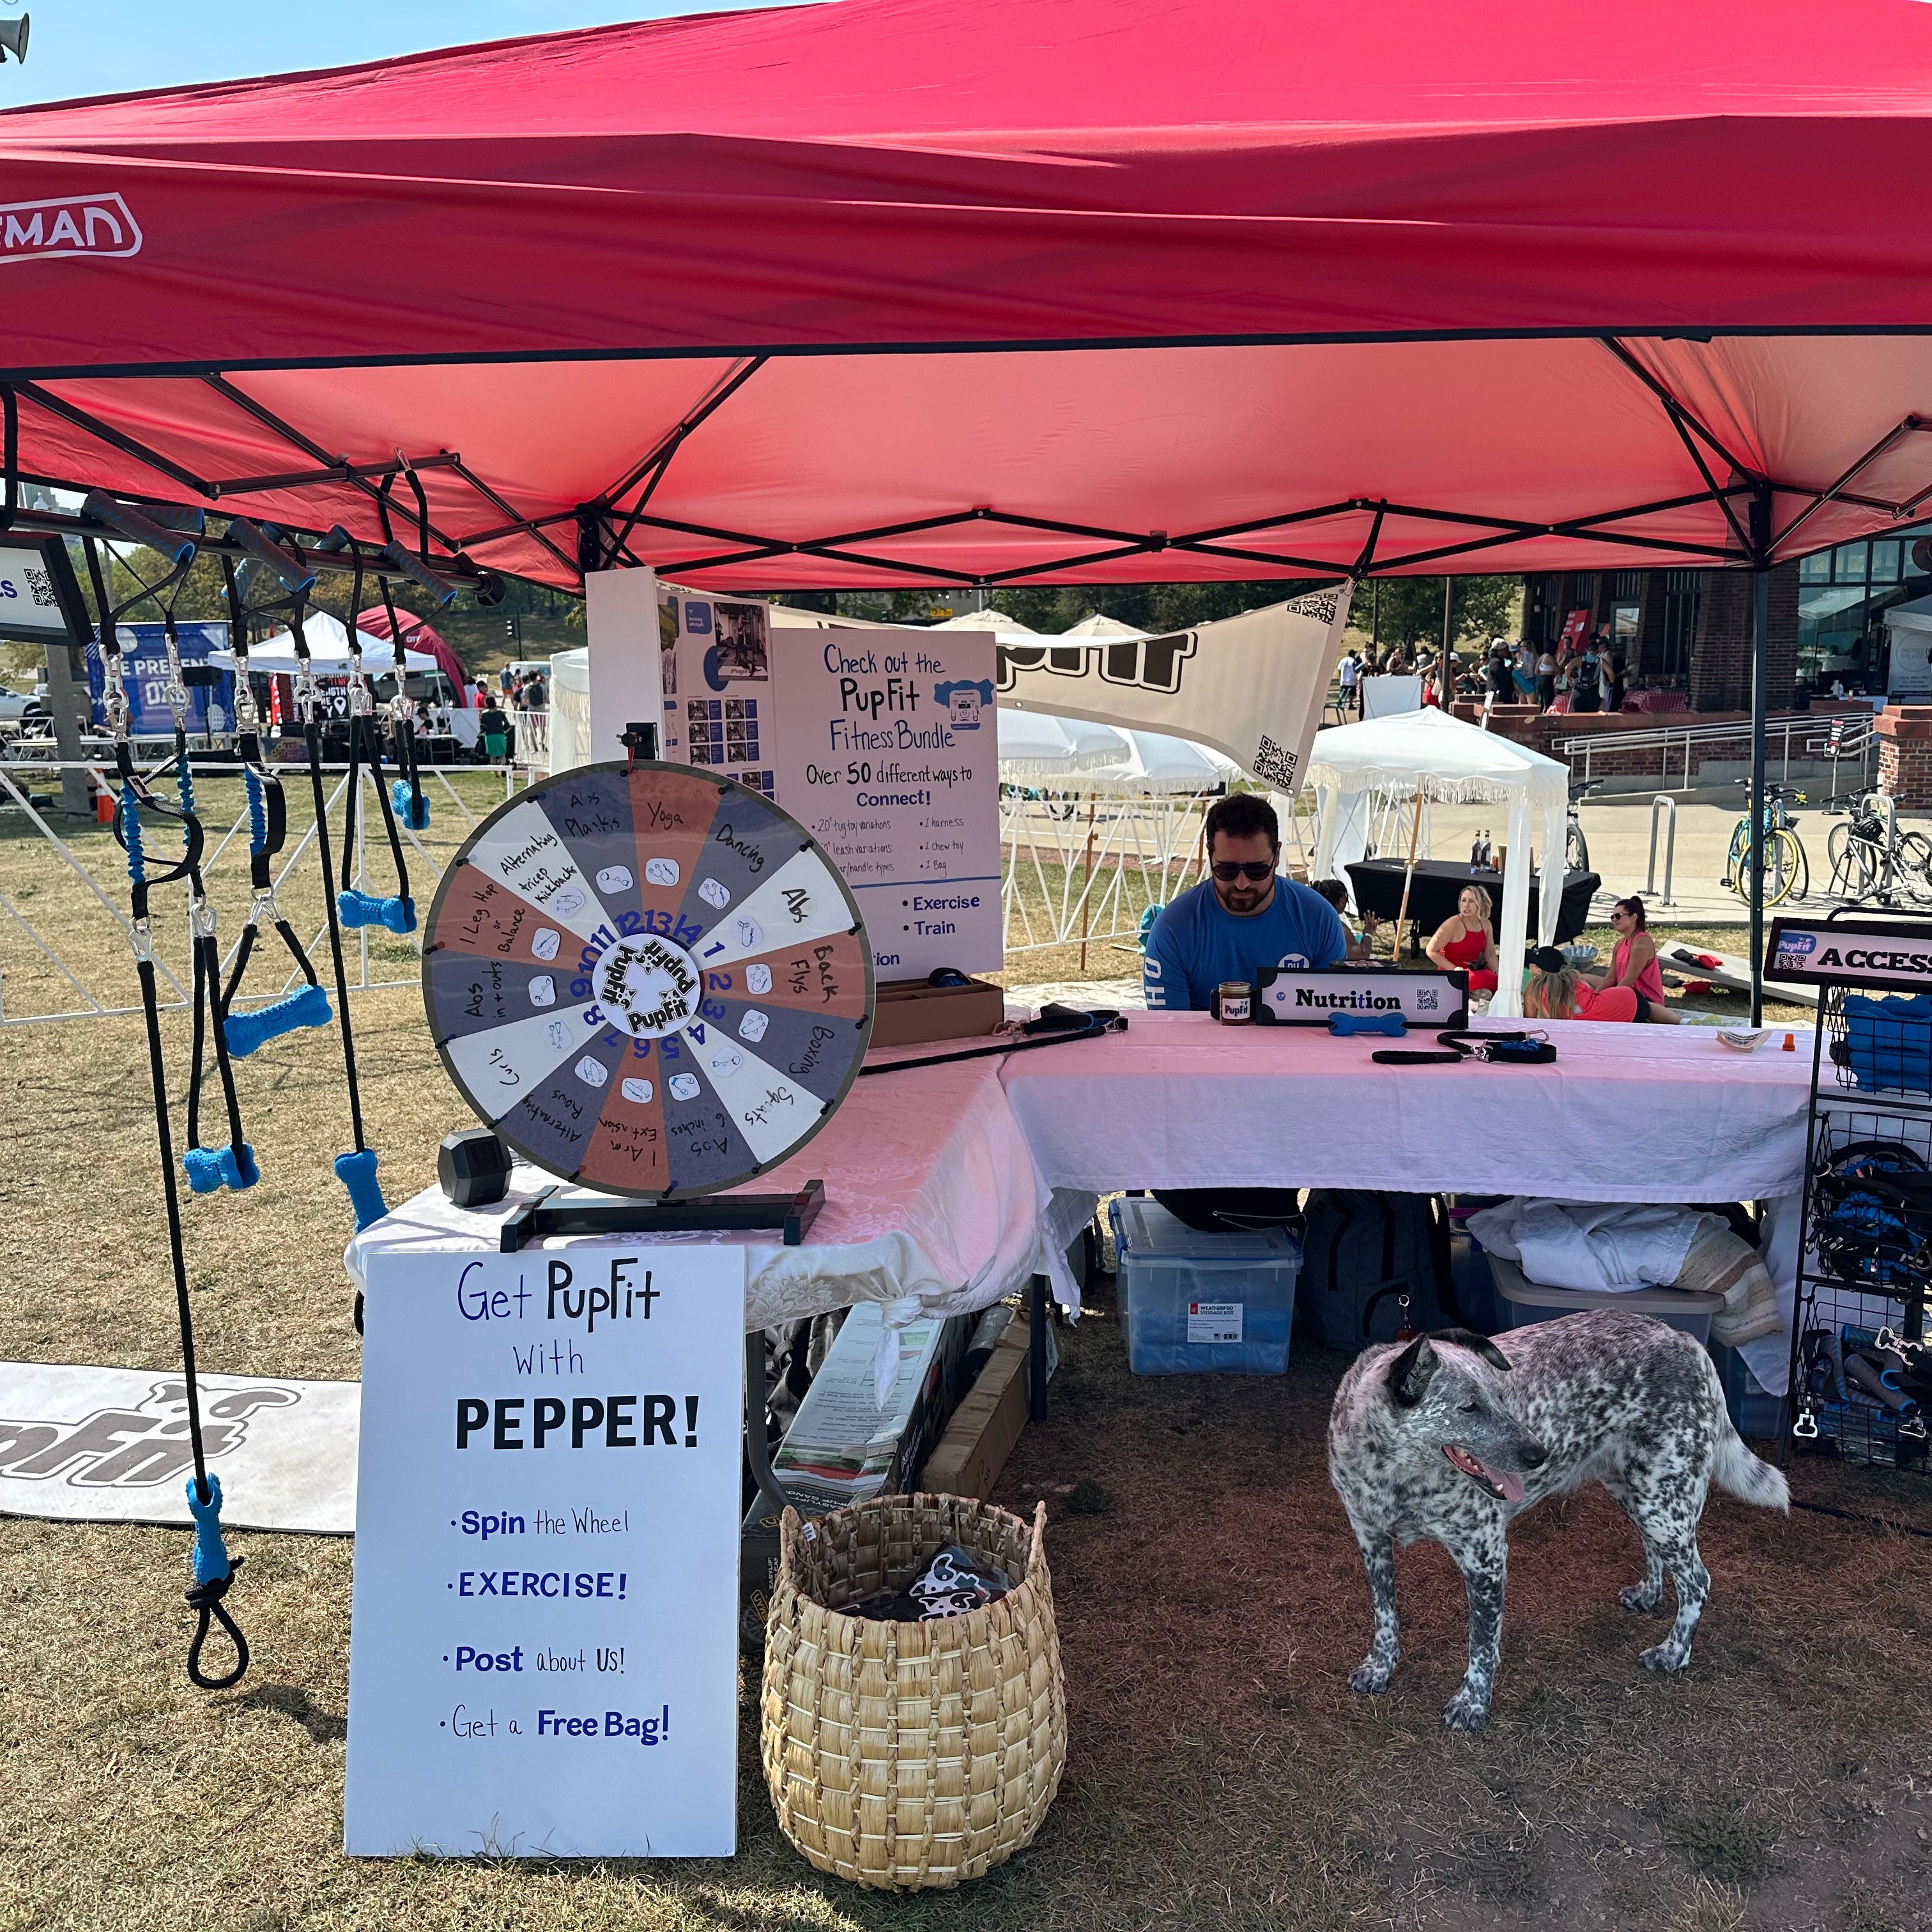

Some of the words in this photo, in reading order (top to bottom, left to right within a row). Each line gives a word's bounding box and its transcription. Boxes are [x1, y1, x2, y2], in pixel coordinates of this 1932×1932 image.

[0, 207, 123, 248] MAN
[824, 643, 878, 674] Check
[884, 652, 908, 673] out
[915, 652, 946, 673] the
[840, 677, 920, 721] PupFit
[830, 718, 894, 751] Fitness
[894, 719, 956, 750] Bundle
[806, 763, 842, 785] Over
[847, 761, 871, 785] 50
[877, 760, 929, 783] different
[930, 767, 958, 789] ways
[960, 765, 972, 782] to
[857, 790, 931, 807] Connect!
[647, 801, 684, 830] Yoga
[924, 818, 930, 828] 1
[931, 817, 965, 828] harness
[834, 820, 847, 839] tug
[847, 820, 859, 837] toy
[859, 820, 891, 831] variations
[499, 833, 558, 876] Alternating
[715, 823, 767, 873] Dancing
[833, 841, 854, 855] leash
[854, 842, 893, 854] variations
[924, 841, 930, 850] 1
[931, 841, 950, 850] chew
[951, 839, 965, 855] toy
[518, 867, 548, 893] tricep
[875, 862, 894, 877] types
[924, 859, 930, 869] 1
[933, 860, 948, 878] Bag
[473, 883, 500, 903] Hop
[781, 889, 810, 924] Abs
[913, 895, 980, 911] Exercise
[463, 908, 491, 935] Leg
[493, 919, 501, 930] or
[497, 908, 526, 953] Balance
[615, 910, 645, 937] 12
[644, 908, 673, 934] 13
[673, 914, 703, 944] 14
[914, 921, 956, 935] Train
[590, 924, 617, 951] 11
[703, 941, 726, 959] 1
[578, 946, 601, 973] 10
[643, 940, 697, 996] PupFit
[1778, 940, 1811, 952] PupFit
[1818, 948, 1932, 974] ACCES
[481, 961, 502, 990] outs
[601, 944, 638, 1006] PupFit
[709, 973, 733, 991] 2
[788, 959, 810, 995] Flys
[814, 945, 839, 1004] Back
[464, 983, 484, 1017] Abs
[493, 1007, 506, 1018] in
[702, 998, 726, 1020] 3
[1225, 1005, 1248, 1016] PupFit
[1295, 988, 1401, 1011] Nutrition
[583, 1005, 606, 1026] 8
[627, 999, 689, 1032] PupFit
[686, 1023, 706, 1046] 4
[661, 1037, 680, 1060] 5
[789, 1026, 836, 1076] Boxing
[489, 1048, 520, 1085] Curls
[522, 1094, 583, 1143] Alternating
[551, 1090, 584, 1120] Rows
[671, 1119, 707, 1135] inches
[715, 1112, 725, 1128] 6
[610, 1140, 643, 1162] Arm
[457, 1261, 532, 1321] Get
[547, 1257, 661, 1333] PupFit
[456, 1394, 700, 1450] PEPPER!
[461, 1510, 525, 1540] Spin
[533, 1508, 566, 1535] the
[572, 1506, 629, 1535] Wheel
[459, 1571, 627, 1600] EXERCISE!
[456, 1646, 524, 1673] Post
[537, 1647, 586, 1673] about
[452, 1704, 498, 1738] Get
[509, 1719, 523, 1735] a
[537, 1710, 598, 1736] Free
[604, 1705, 670, 1746] Bag!
